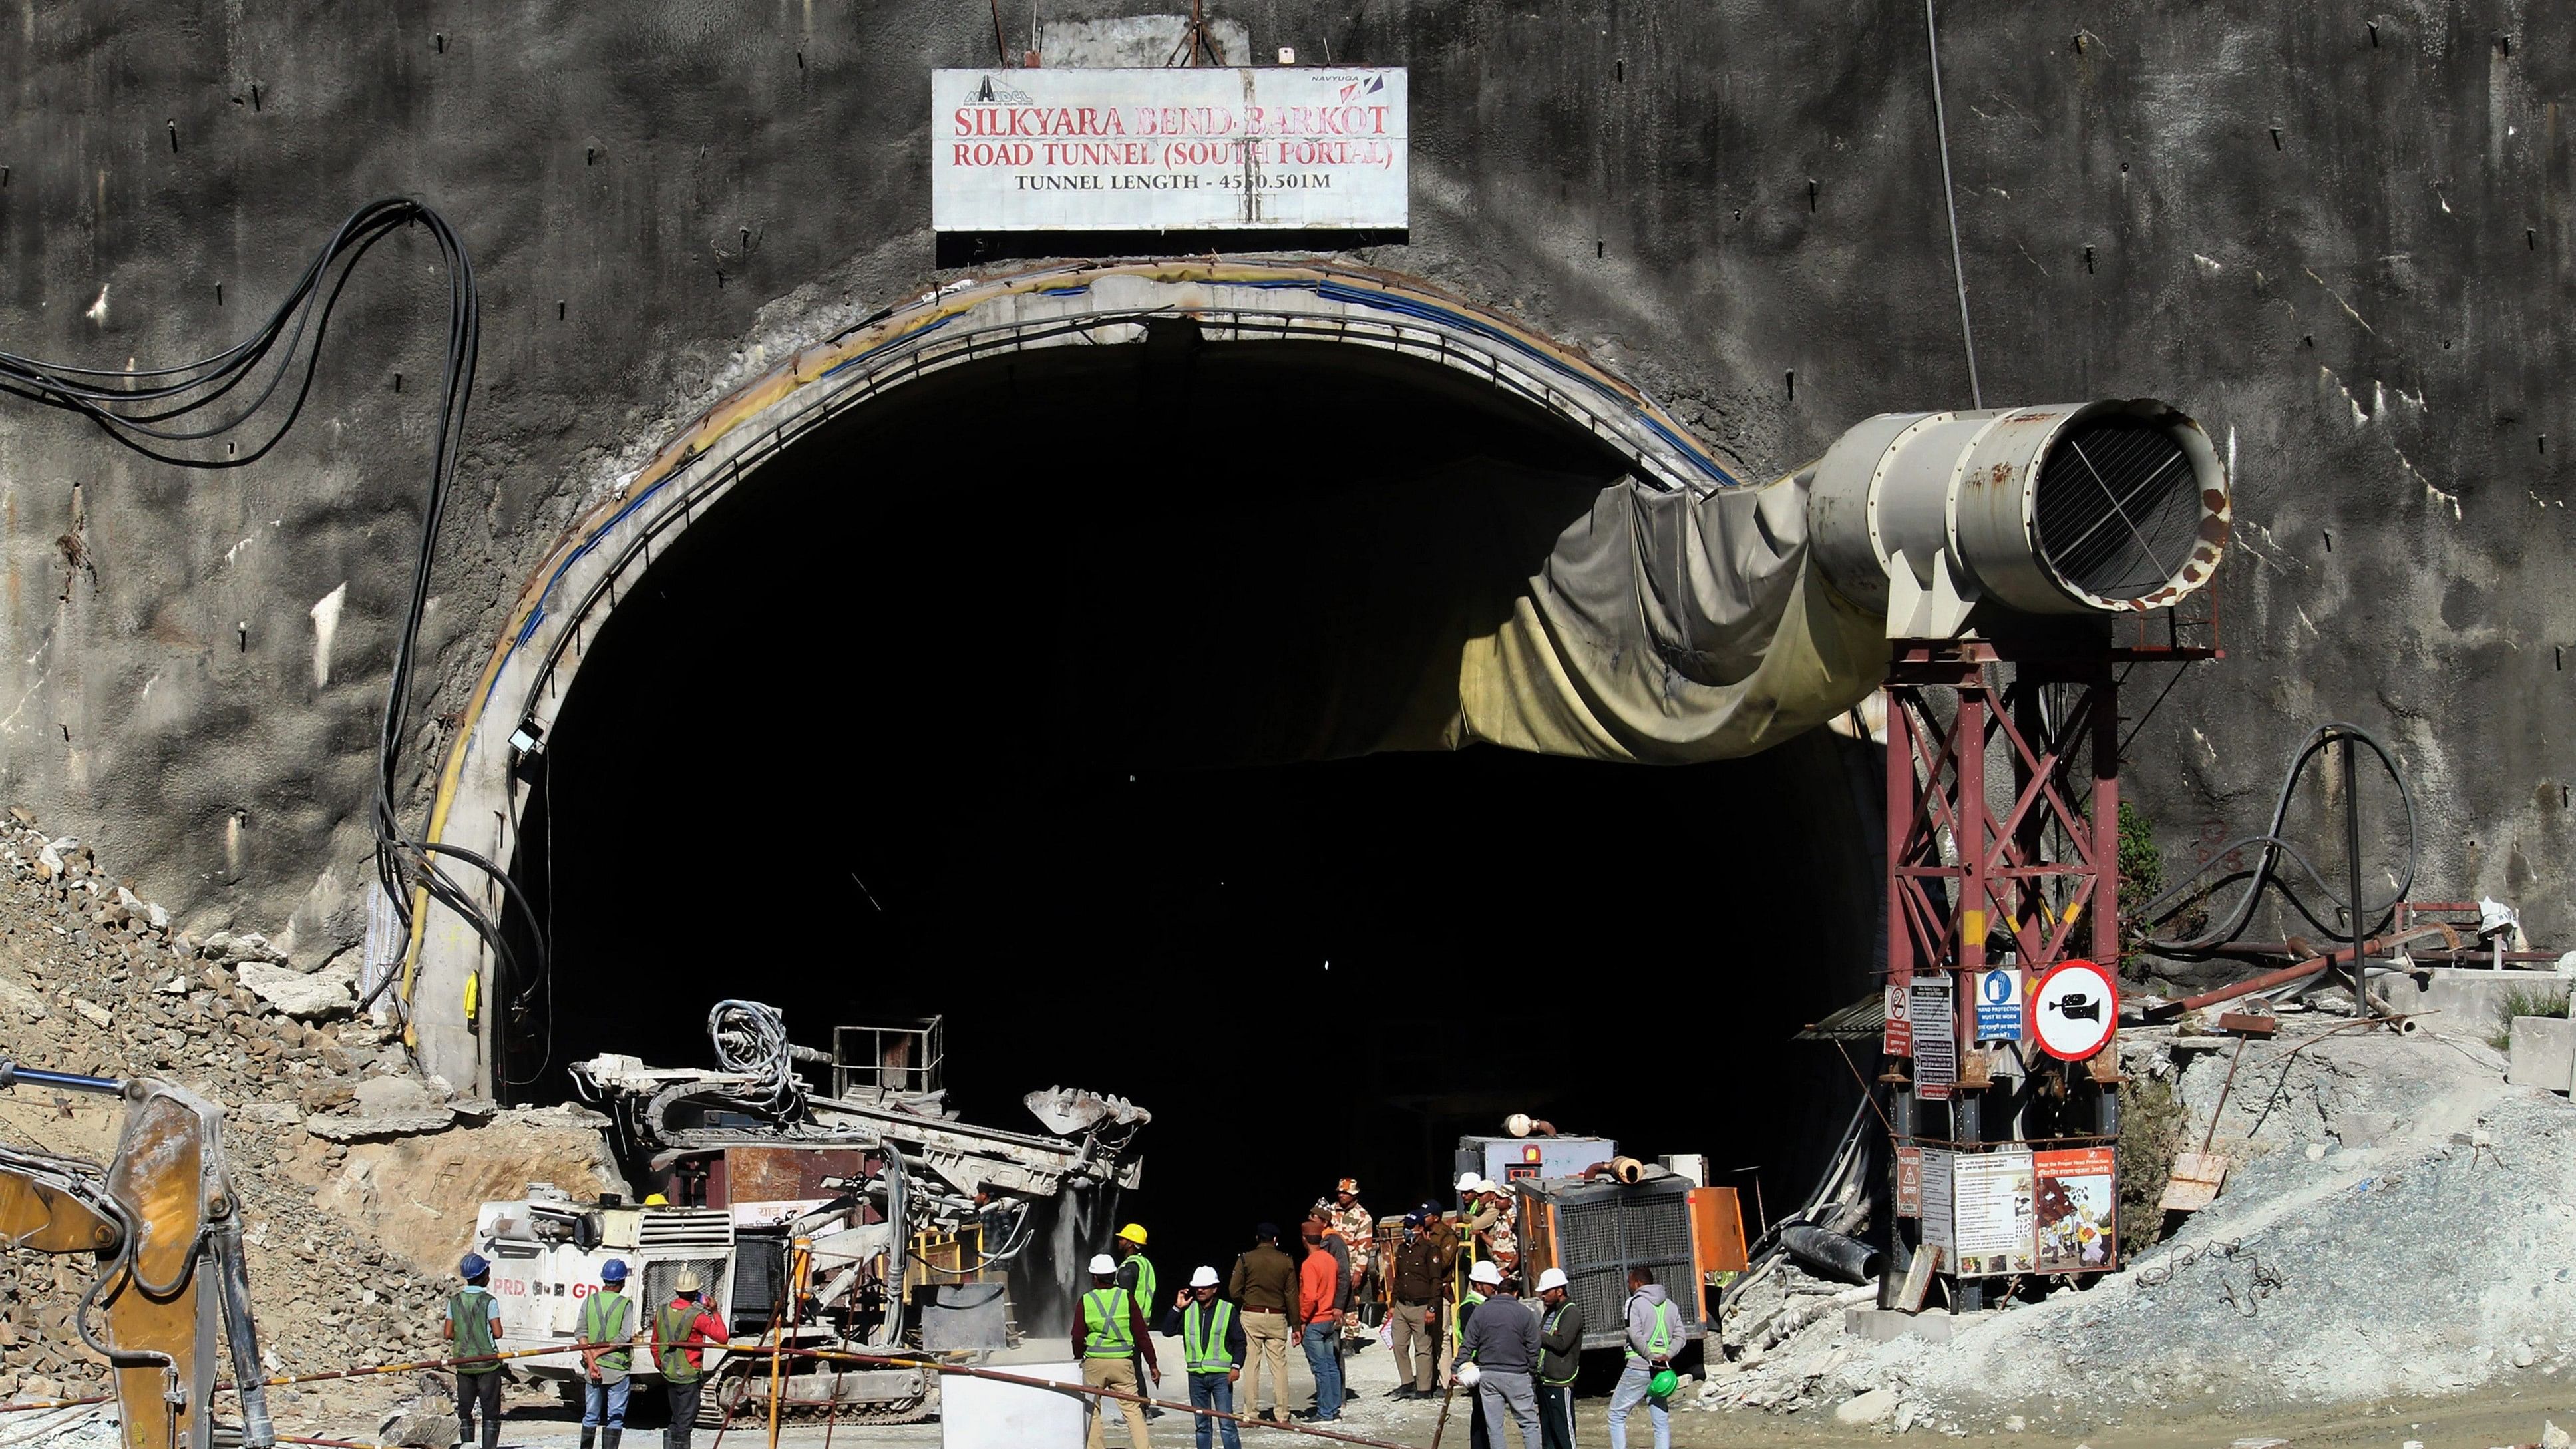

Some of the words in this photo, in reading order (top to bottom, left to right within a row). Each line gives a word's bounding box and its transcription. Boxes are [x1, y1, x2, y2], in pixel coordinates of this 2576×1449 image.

[954, 107, 1127, 136] SILKYARA
[952, 144, 1033, 166] ROAD
[1043, 143, 1155, 166] TUNNEL
[1164, 142, 1270, 170] (SOUTH
[1278, 142, 1393, 170] PORTAL)
[1015, 175, 1104, 190] TUNNEL
[1111, 174, 1199, 190] LENGTH
